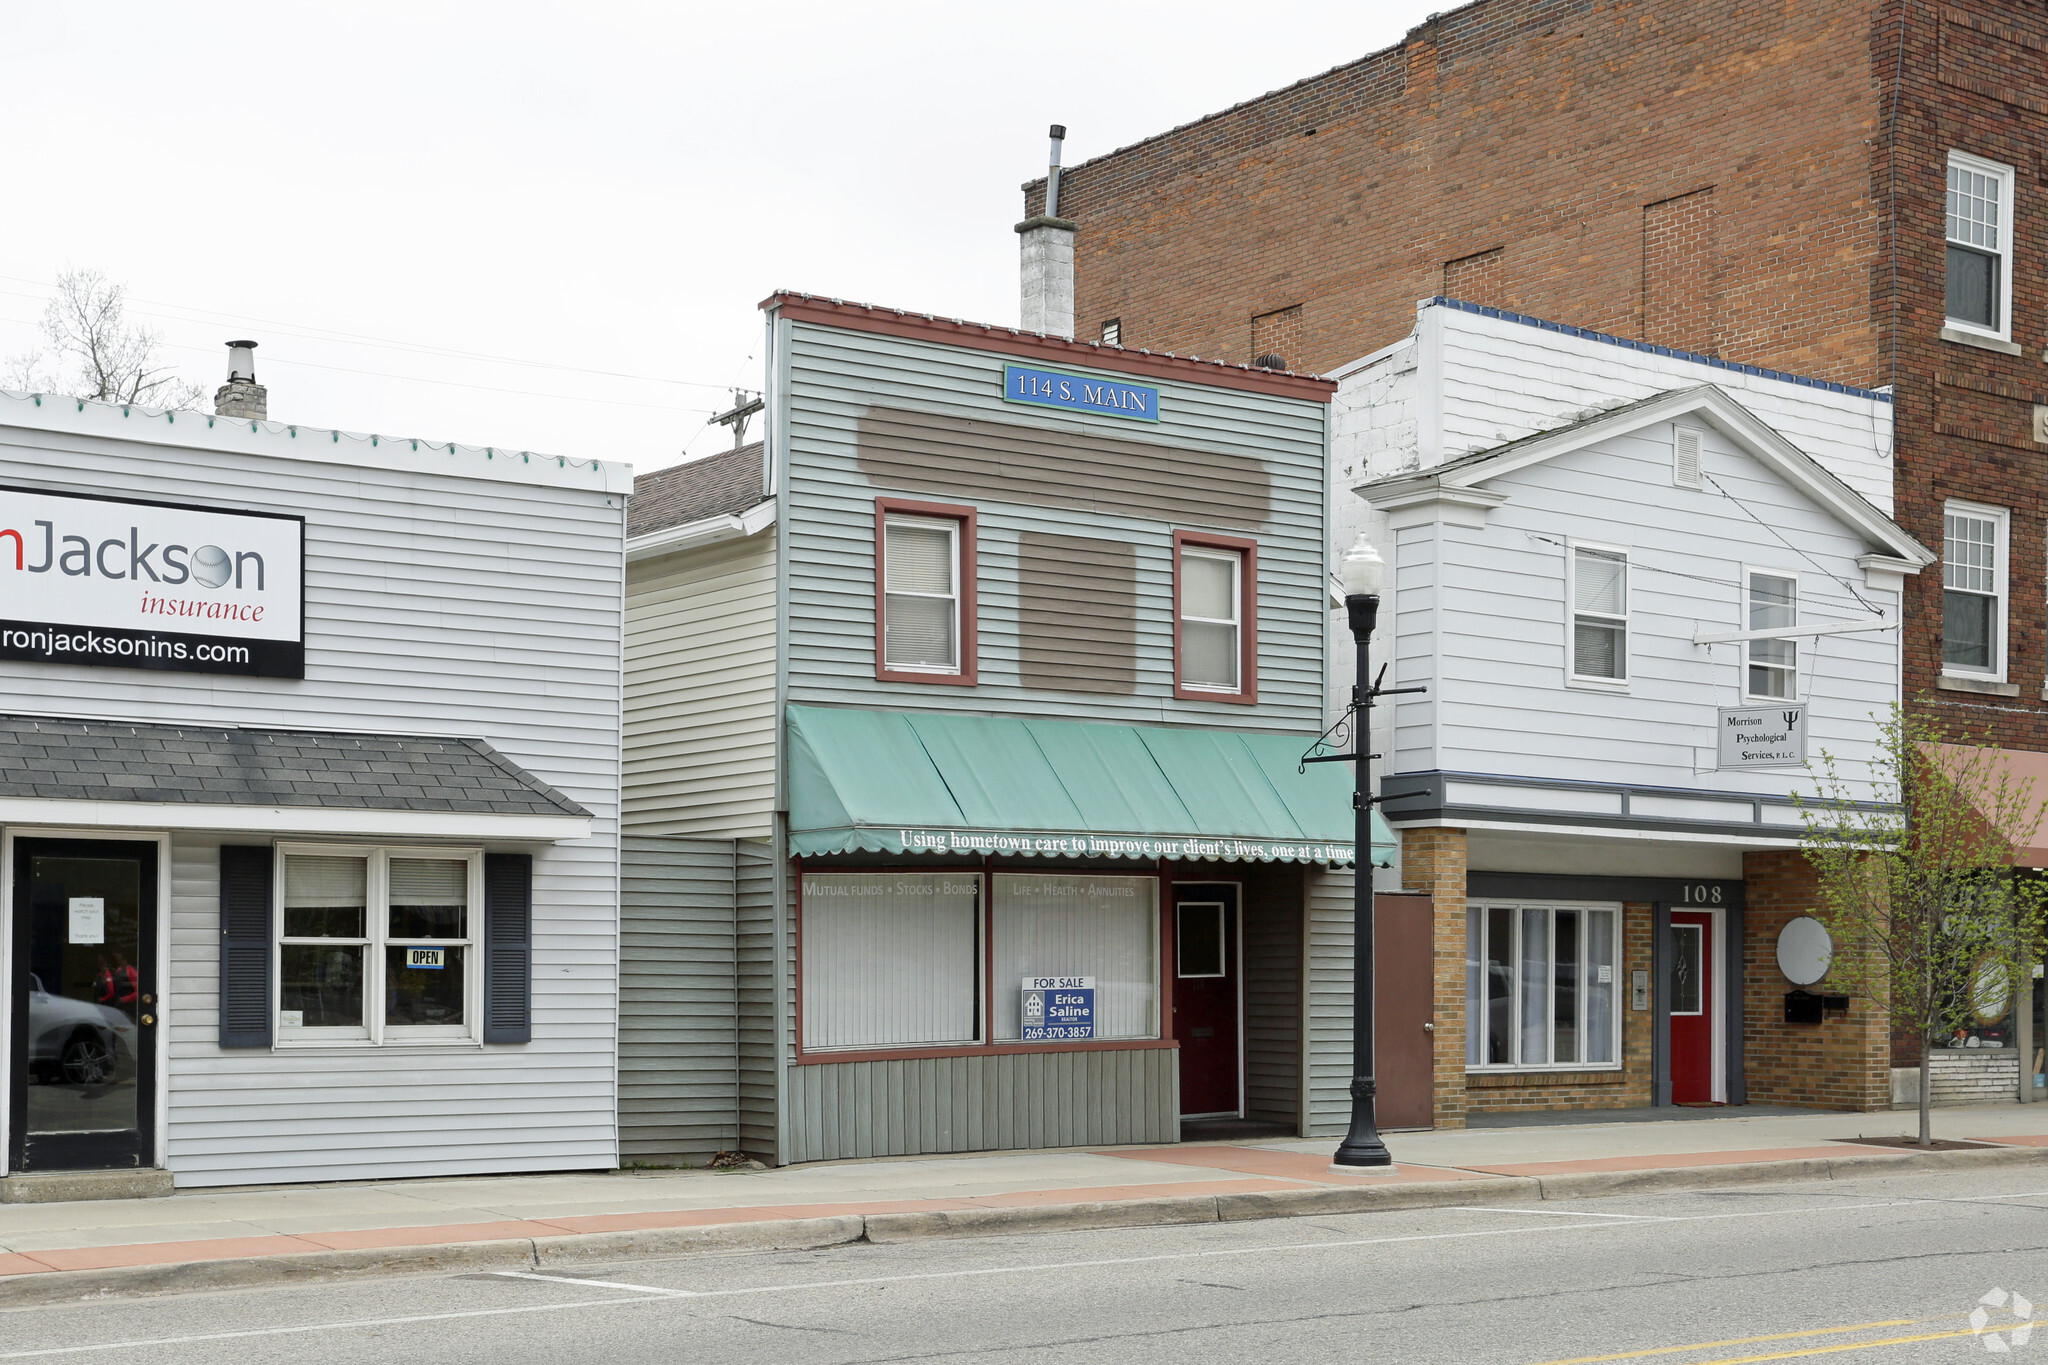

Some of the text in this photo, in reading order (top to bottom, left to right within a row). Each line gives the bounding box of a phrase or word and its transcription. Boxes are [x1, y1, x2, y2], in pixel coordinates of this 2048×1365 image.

[1017, 375, 1147, 413] 114 S. MAIN
[140, 590, 265, 623] insurance
[2, 627, 250, 664] ronjacksonins.com
[1727, 716, 1763, 727] Morrison
[1735, 732, 1787, 745] Psychological
[1741, 750, 1775, 761] Services,
[899, 829, 1354, 859] Using hometown care to improve our client's lives, one at a time
[1684, 885, 1722, 904] 108
[412, 950, 439, 965] OPEN
[1033, 978, 1084, 988] FOR SALE
[1055, 994, 1084, 1005] Erica
[1049, 1006, 1090, 1017] Saline
[1025, 1026, 1092, 1039] 269-370-3857
